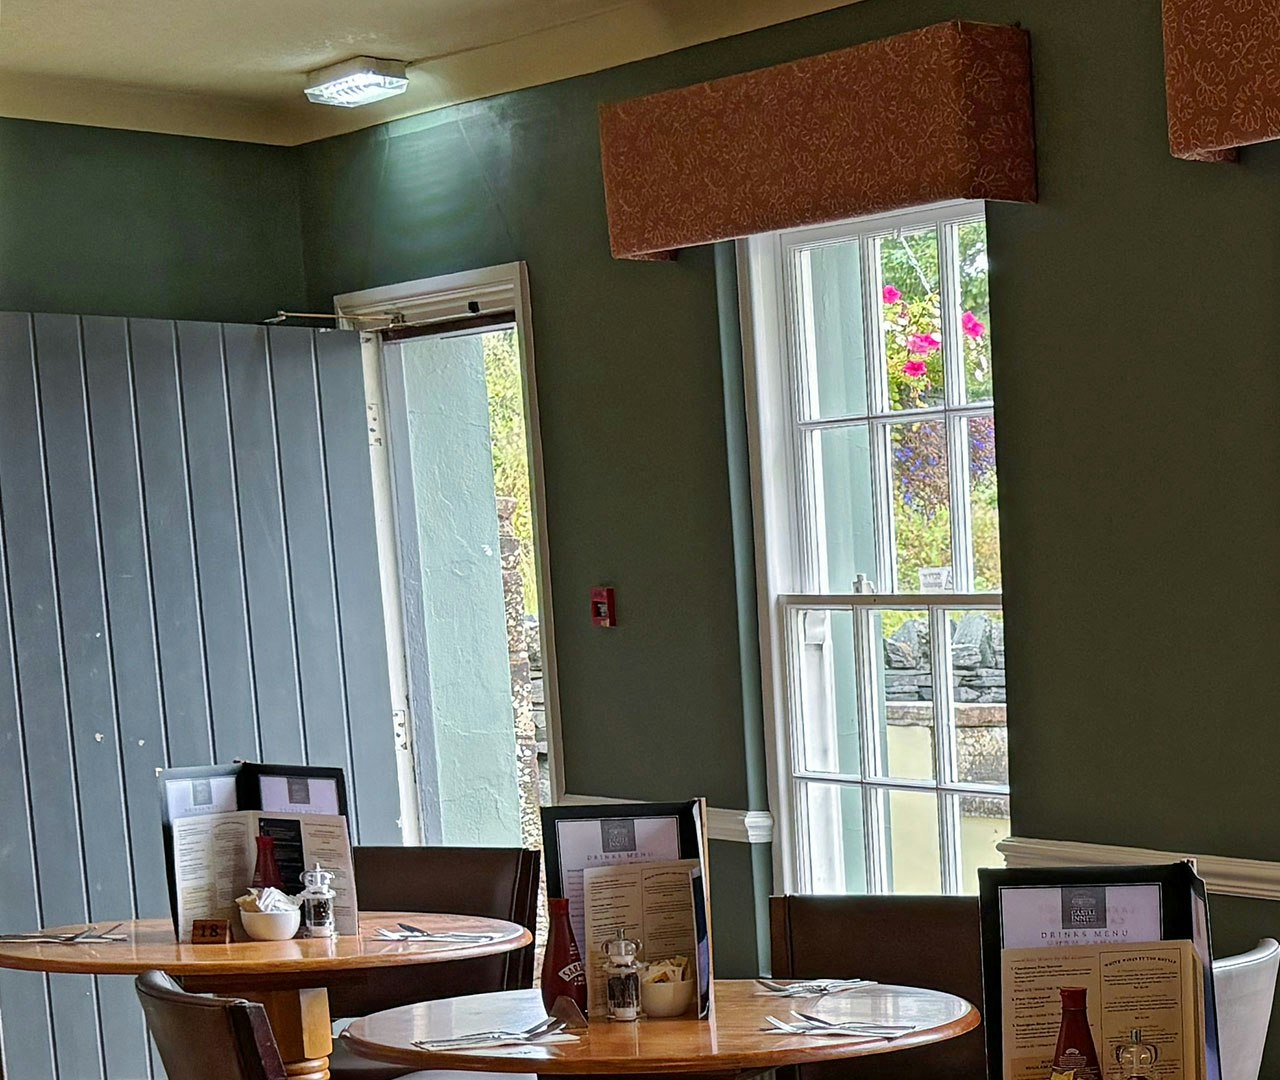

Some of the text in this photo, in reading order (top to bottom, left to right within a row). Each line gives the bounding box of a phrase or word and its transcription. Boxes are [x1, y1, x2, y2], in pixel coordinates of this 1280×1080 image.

[200, 923, 219, 937] 18
[1041, 930, 1129, 939] DRINKS MENU
